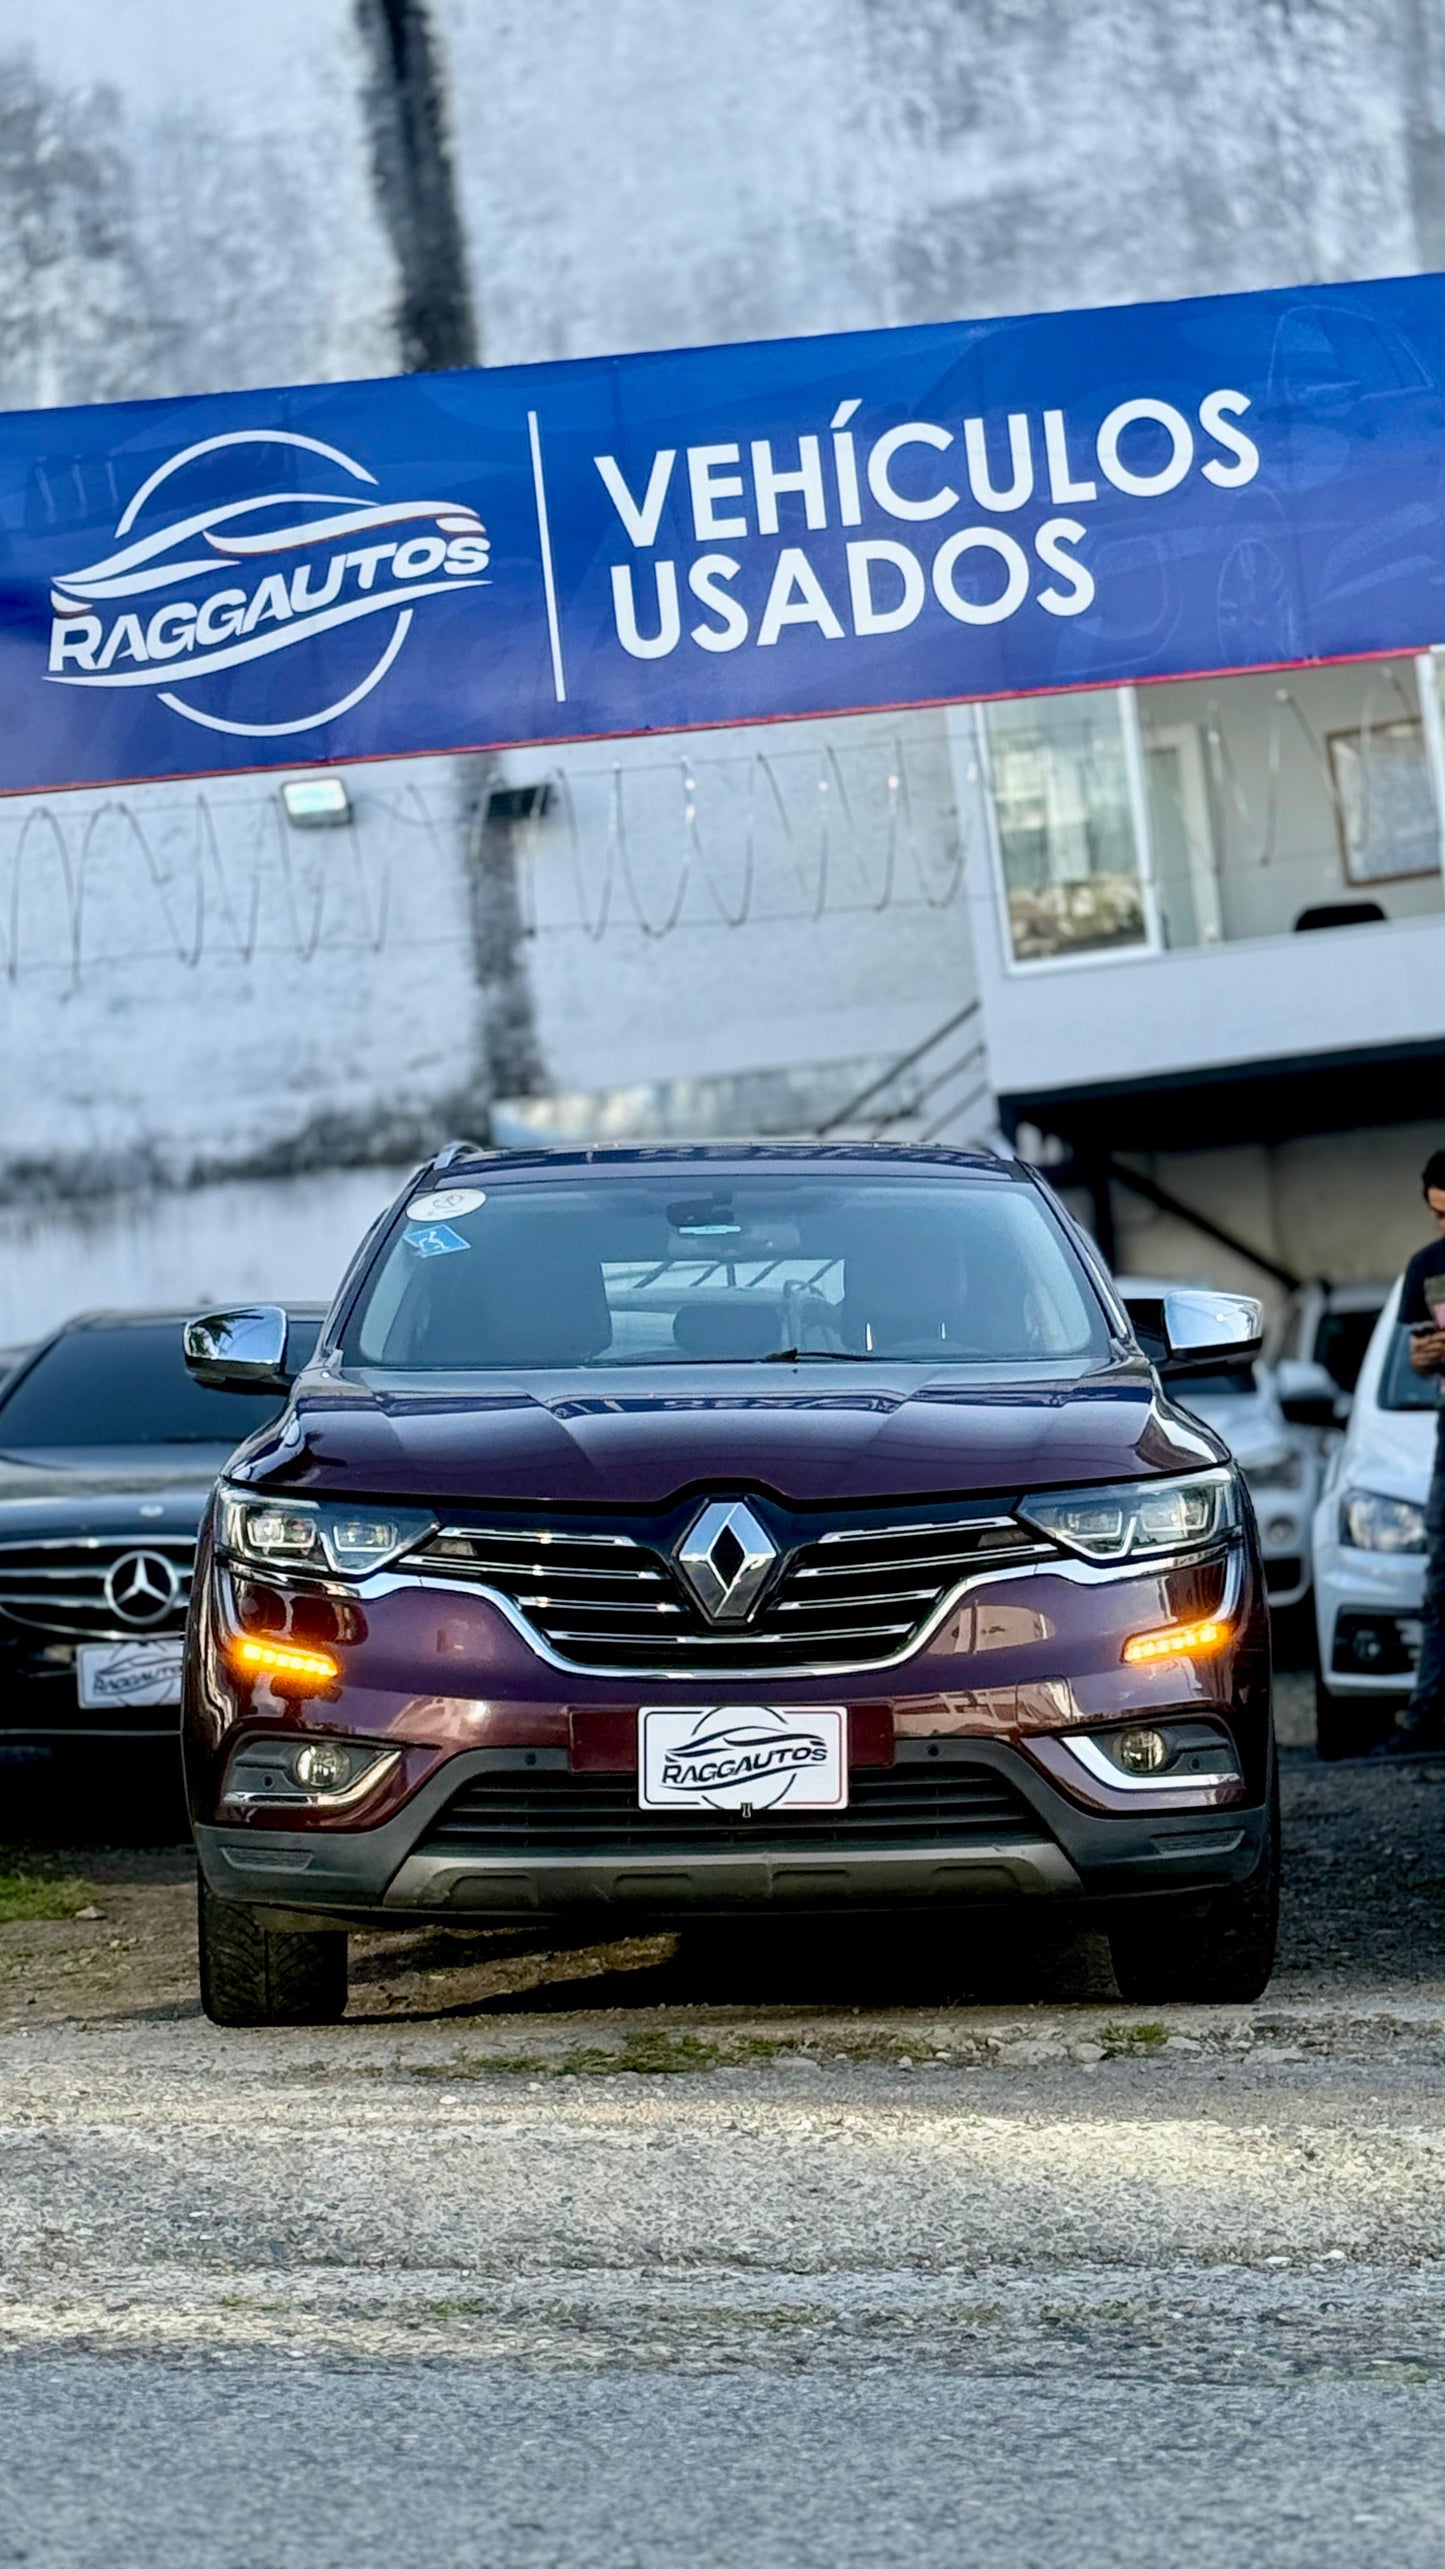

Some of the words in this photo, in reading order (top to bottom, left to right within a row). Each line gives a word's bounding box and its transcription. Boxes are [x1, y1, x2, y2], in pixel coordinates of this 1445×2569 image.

[594, 389, 1260, 547] VEHÍCULOS
[49, 536, 491, 671] RAGGAUTOS
[611, 518, 1095, 659] USADOS
[661, 1747, 828, 1784] RAGGAUTOS
